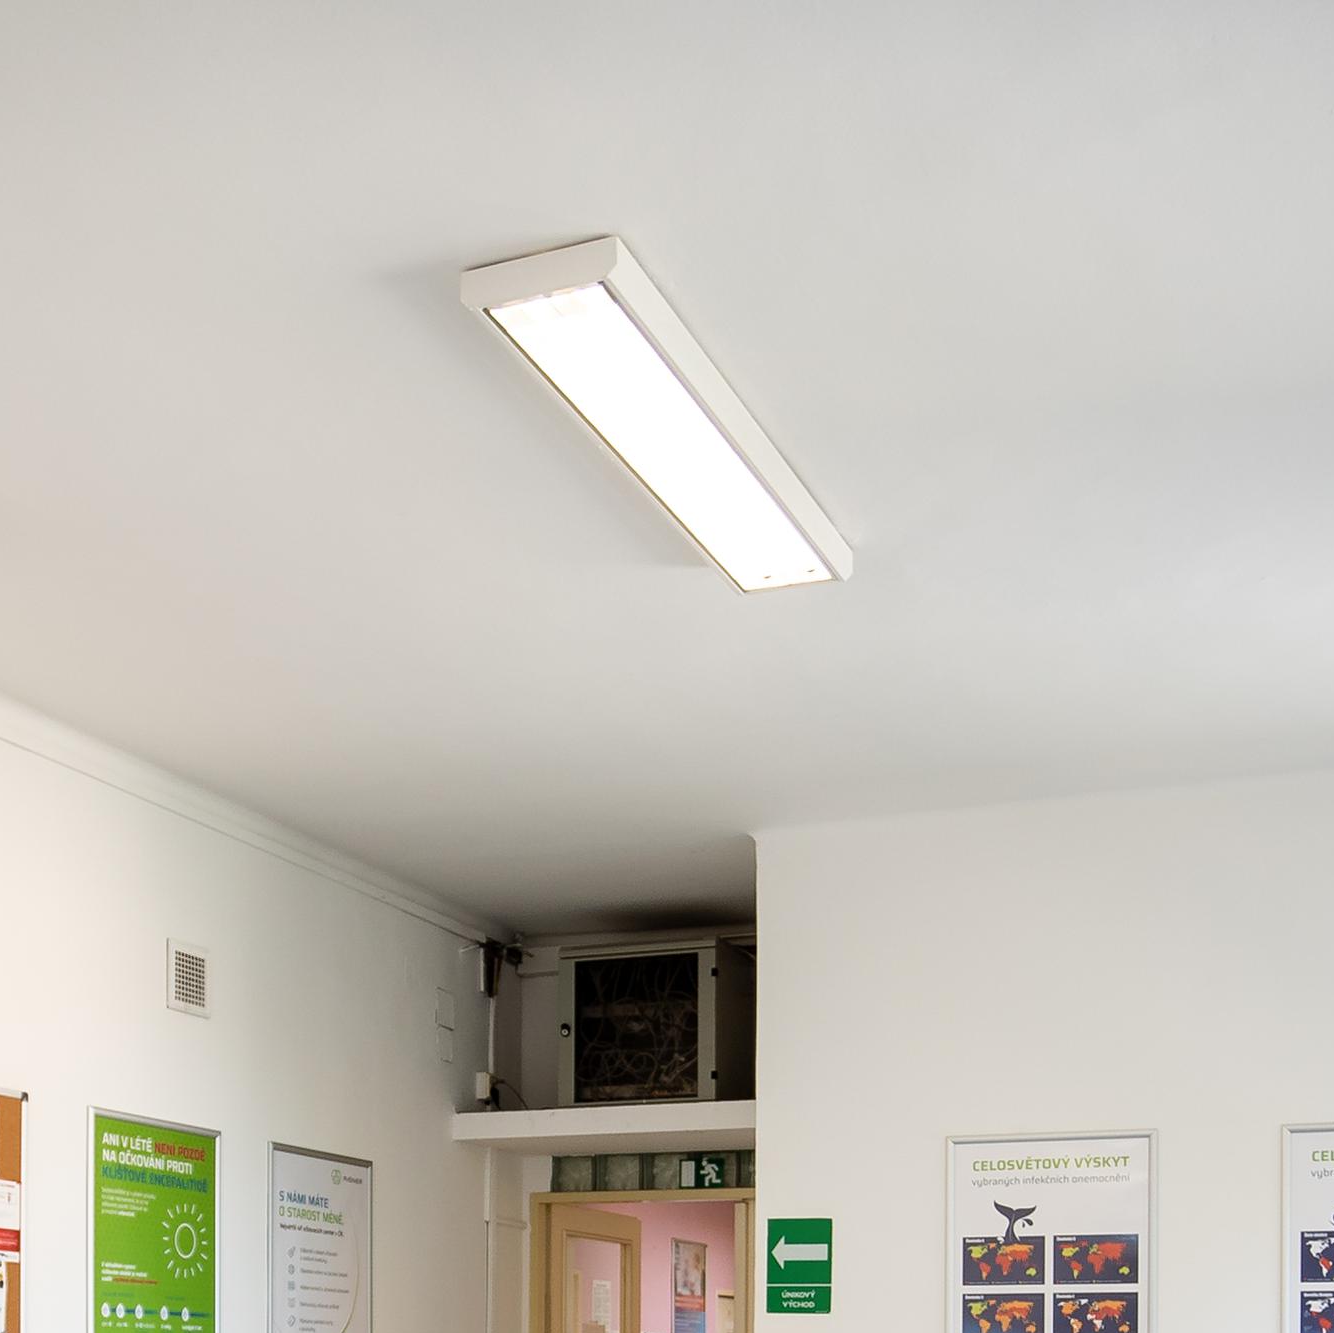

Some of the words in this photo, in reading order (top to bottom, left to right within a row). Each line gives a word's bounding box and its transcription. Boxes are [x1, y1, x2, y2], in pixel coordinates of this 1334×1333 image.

[102, 1132, 119, 1147] ANI
[121, 1135, 129, 1148] V
[130, 1135, 152, 1153] LÉTÉ
[102, 1149, 116, 1163] NA
[119, 1150, 165, 1171] OČKOVÁNÍ
[167, 1160, 193, 1175] PROTI
[972, 1156, 1070, 1173] CELOSVĚTOVÝ
[1073, 1154, 1130, 1169] VÝSKYT
[972, 1176, 1021, 1188] vybraných
[1022, 1175, 1069, 1186] infekčních
[1071, 1174, 1131, 1184] onemocnění
[279, 1190, 285, 1202] S
[286, 1190, 307, 1206] NÁMI
[308, 1193, 330, 1209] MÁTE
[279, 1206, 285, 1217] O
[287, 1207, 321, 1222] STAROST
[781, 1289, 816, 1299] ÚNIKOVÝ
[782, 1300, 816, 1308] VÝCHOD
